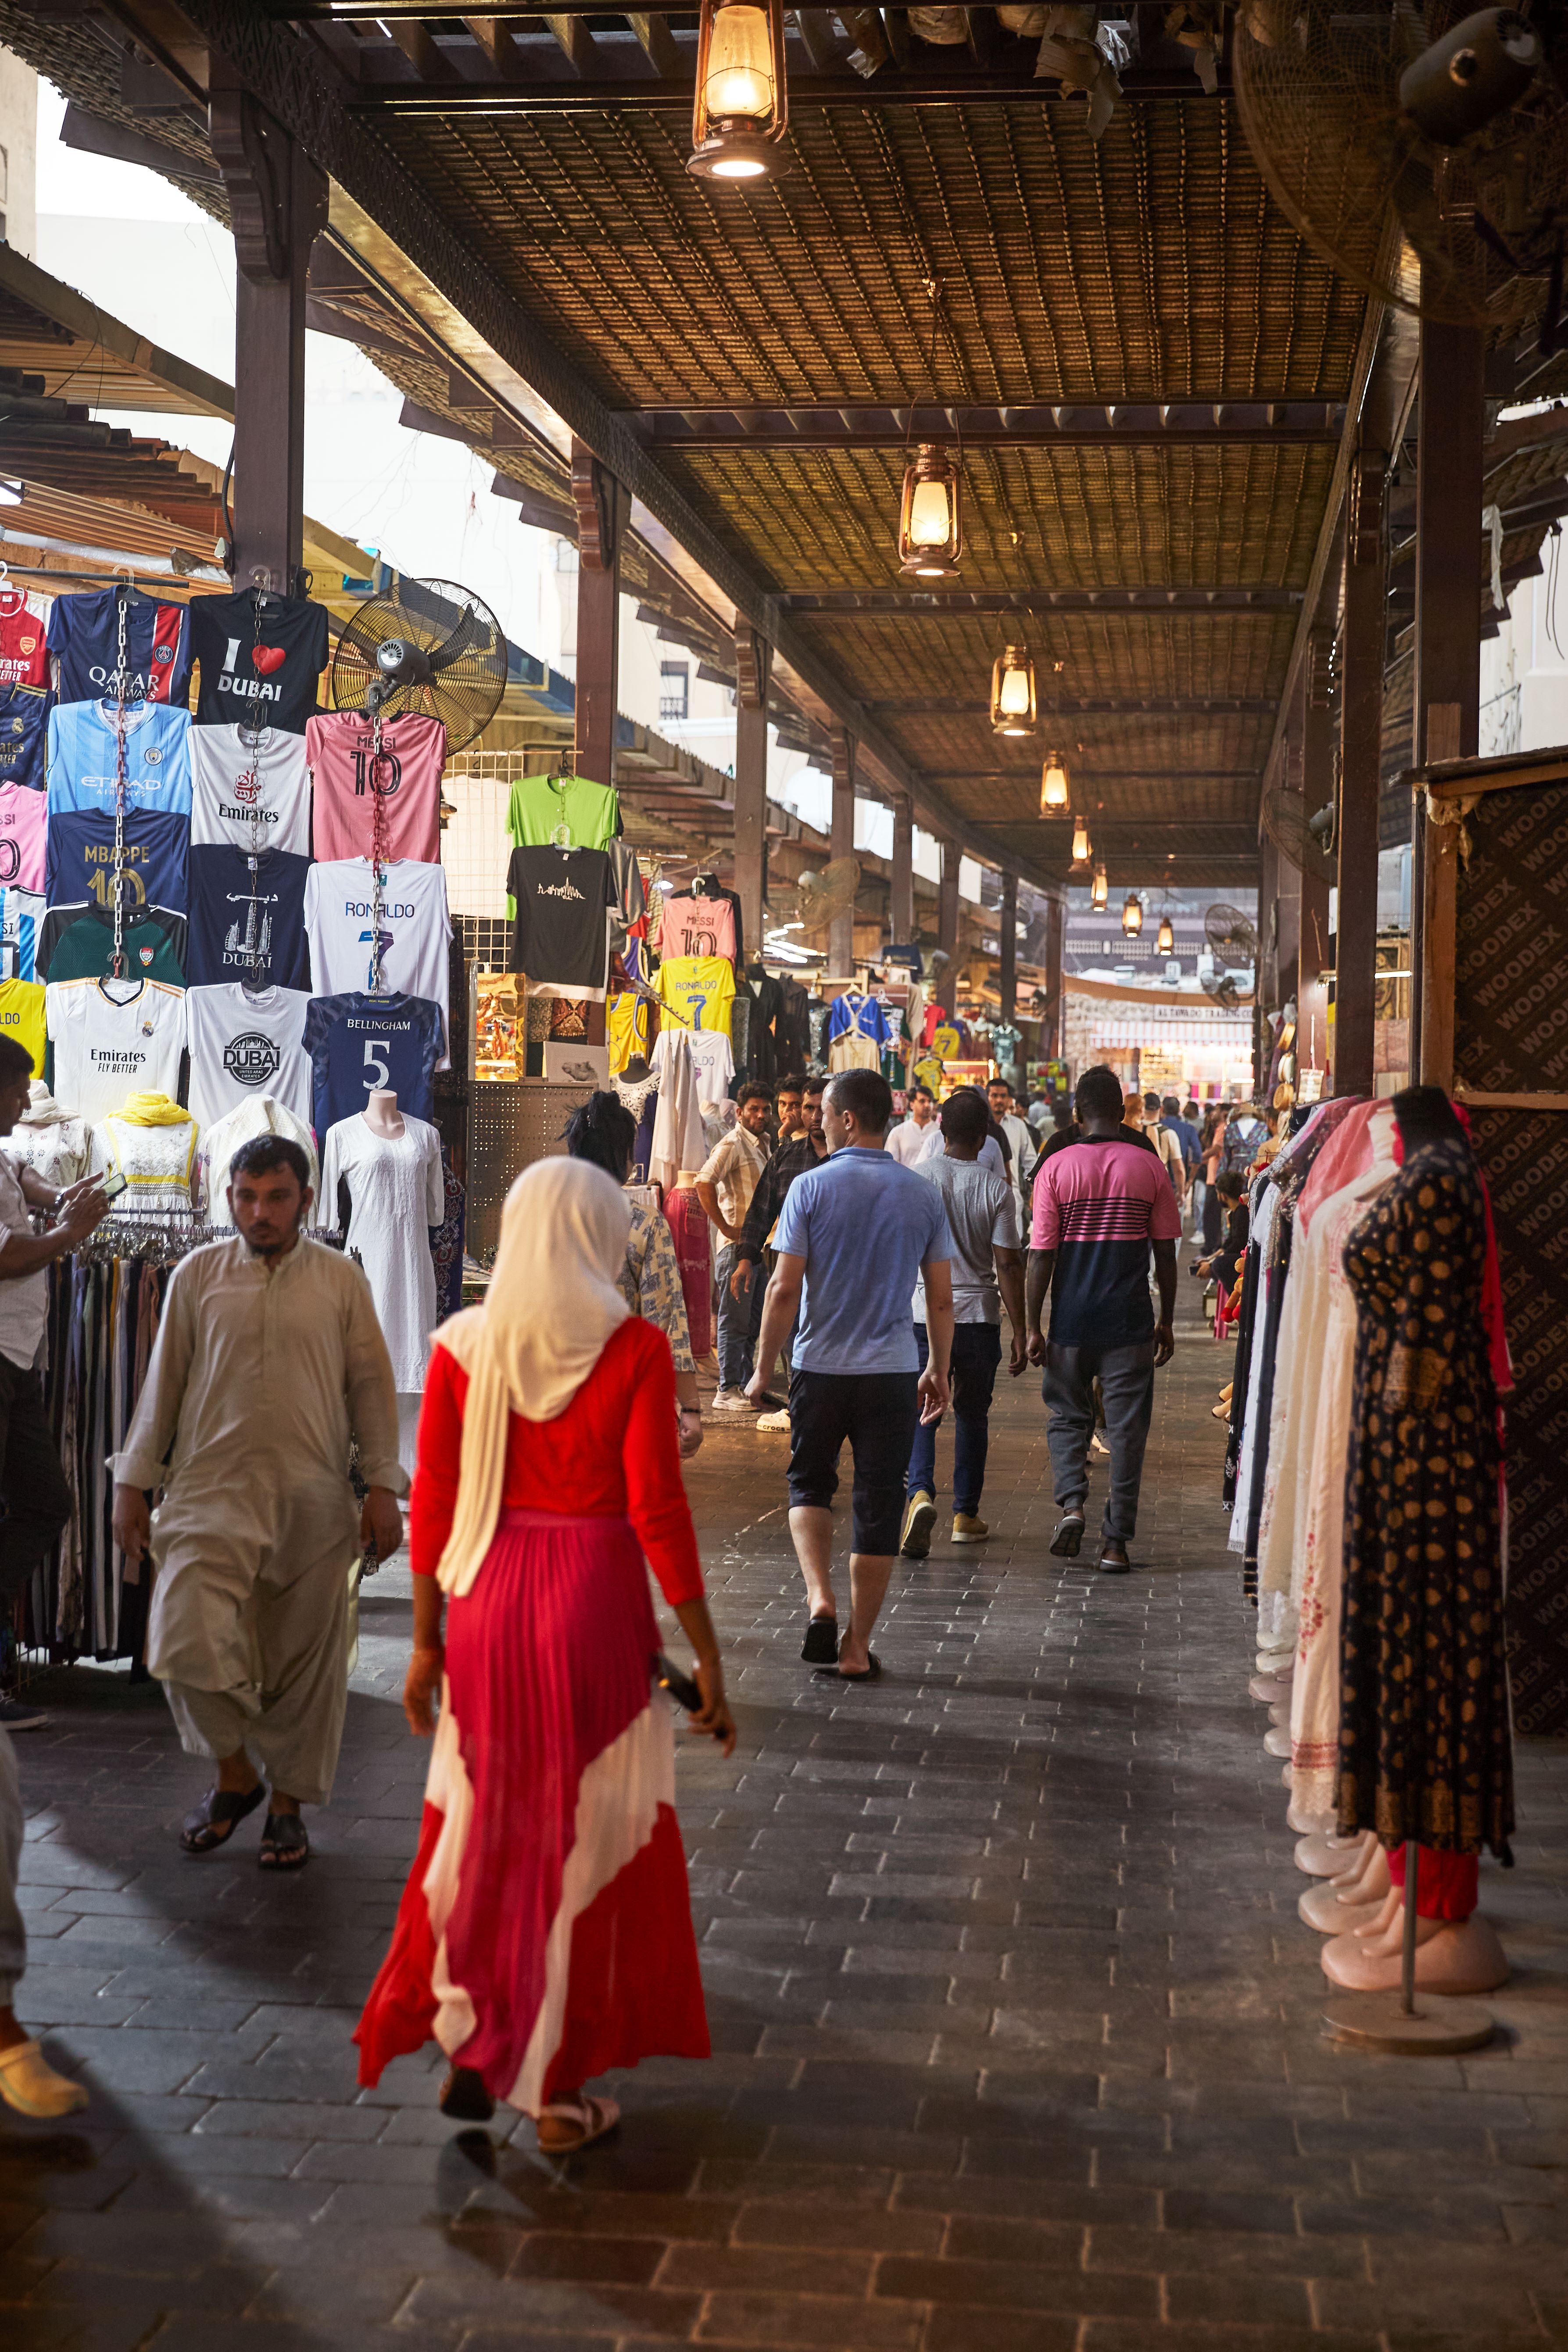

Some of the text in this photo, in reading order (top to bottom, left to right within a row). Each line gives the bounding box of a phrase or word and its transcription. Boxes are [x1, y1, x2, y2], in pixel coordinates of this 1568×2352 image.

[222, 638, 241, 673] I
[104, 685, 156, 700] AIWAYS
[217, 674, 282, 701] DUBAI
[357, 736, 396, 749] MESI
[350, 751, 402, 796] 10
[81, 776, 161, 791] ETIHAD
[97, 789, 146, 797] AIRAYS
[219, 803, 279, 823] Emirates
[85, 845, 150, 863] MBAPPE
[86, 868, 146, 908] 10
[345, 902, 415, 918] RONALDO
[687, 916, 714, 926] MESSI
[680, 929, 717, 957] 10
[222, 952, 272, 968] DUBAI
[358, 930, 394, 991] 7
[1472, 923, 1563, 1007] WOODEX
[676, 980, 717, 991] RONALDO
[1496, 954, 1568, 1031] WOODE
[687, 995, 707, 1031] 7
[347, 1019, 410, 1030] BELLINGHAM
[91, 1049, 146, 1062] Emirates
[223, 1050, 280, 1066] DUBAI
[98, 1063, 137, 1073] FLY BETTER
[363, 1040, 390, 1090] 5
